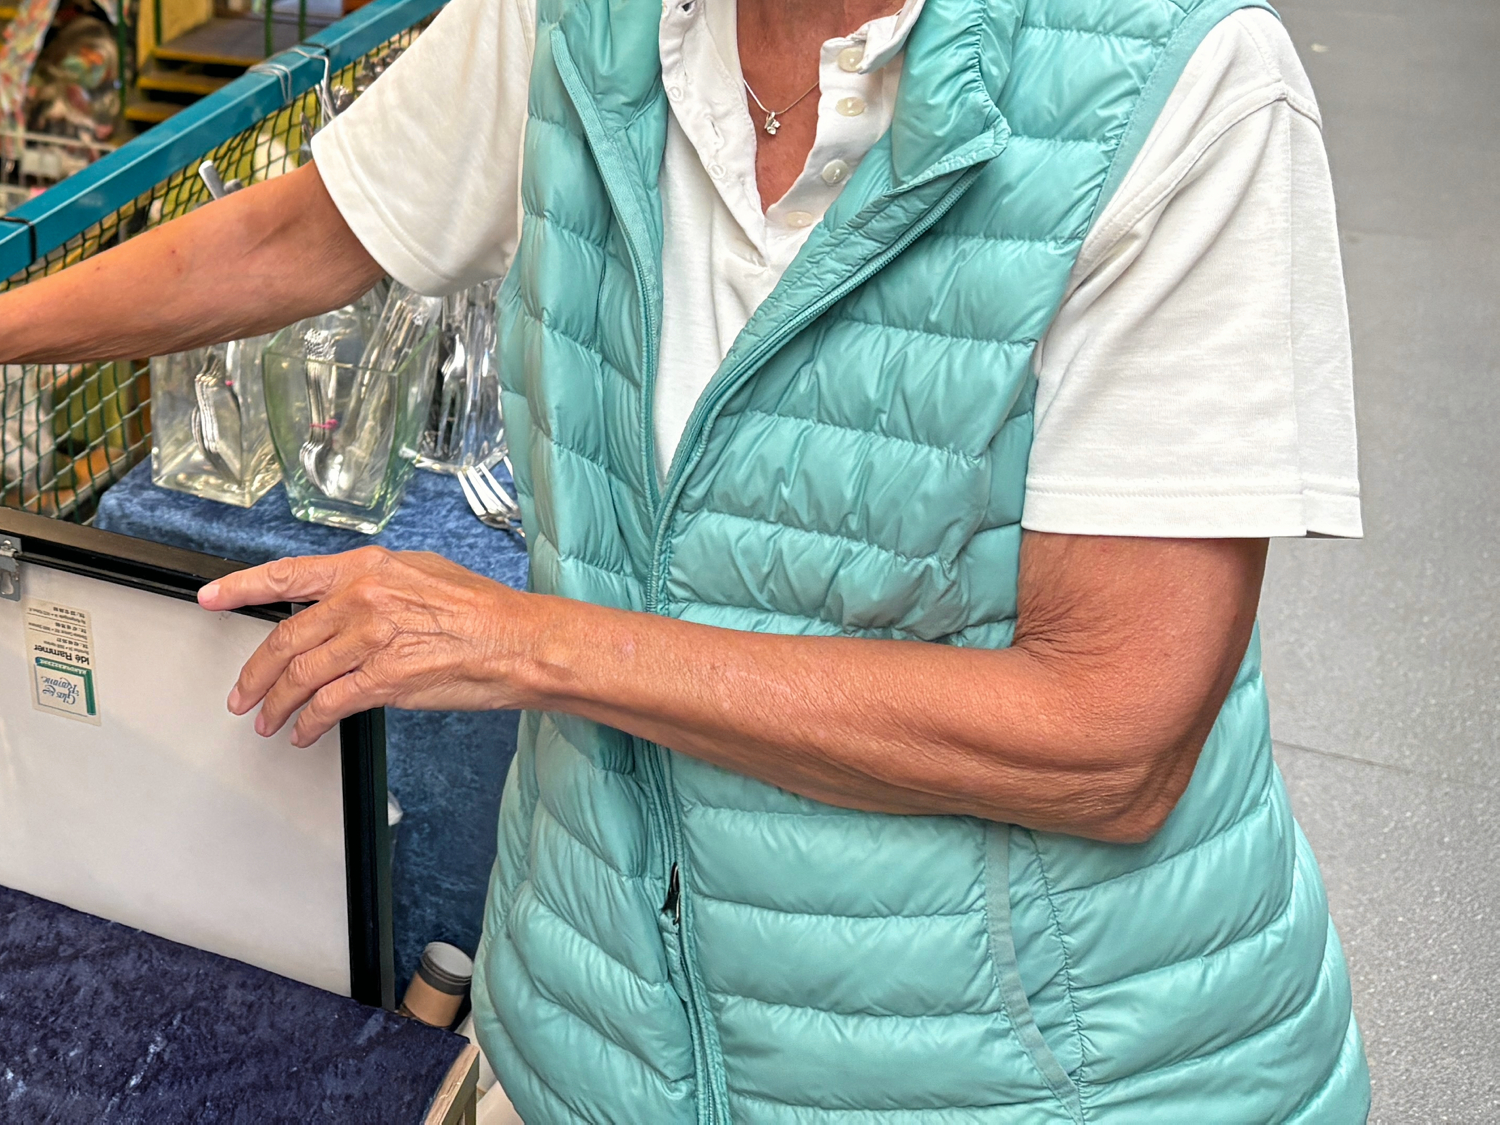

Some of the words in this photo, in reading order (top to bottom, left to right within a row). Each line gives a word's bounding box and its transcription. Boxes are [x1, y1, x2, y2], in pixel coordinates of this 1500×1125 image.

[34, 644, 73, 661] Rammer
[75, 656, 90, 665] Idé
[41, 676, 79, 696] Ramme
[57, 690, 76, 705] Glas
